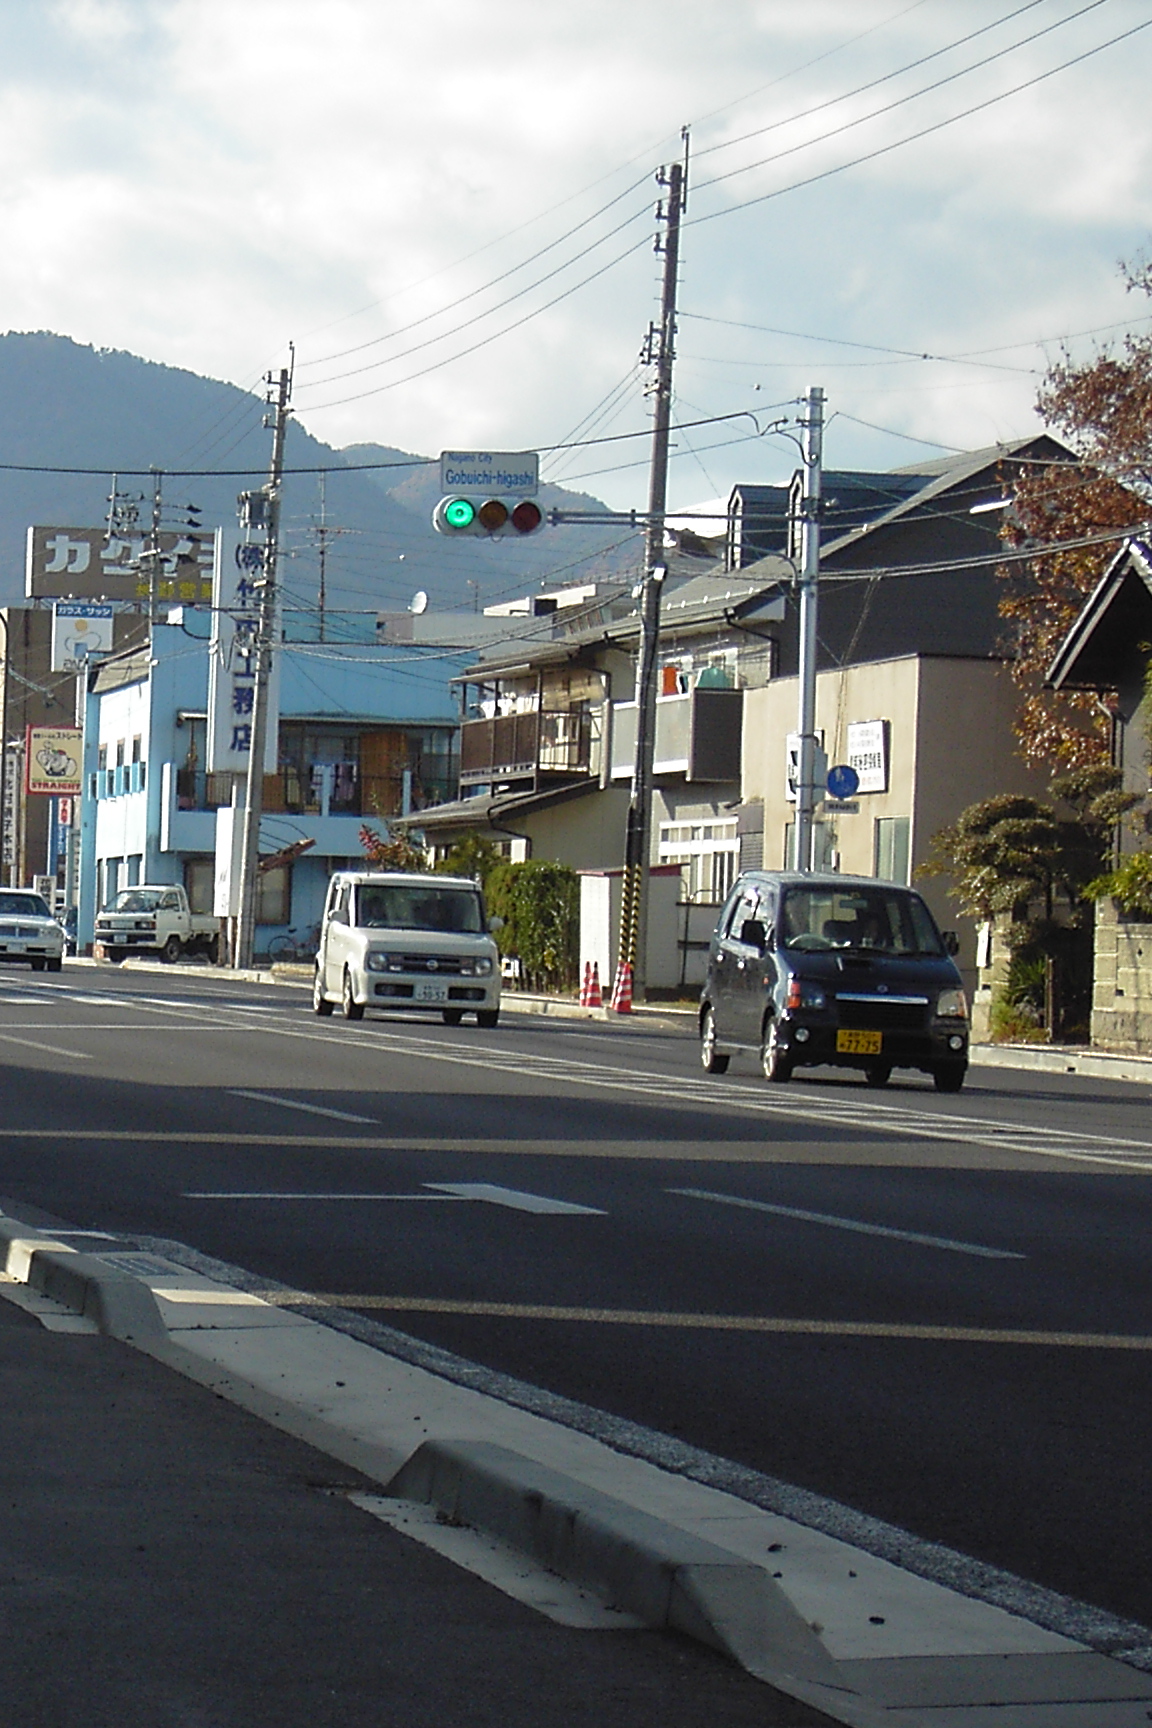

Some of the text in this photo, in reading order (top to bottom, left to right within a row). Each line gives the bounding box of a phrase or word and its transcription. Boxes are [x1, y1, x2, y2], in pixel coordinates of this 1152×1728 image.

[448, 453, 493, 464] Nagano City
[445, 469, 535, 488] Gobuichi-higashi
[31, 782, 81, 790] STRAIGHT
